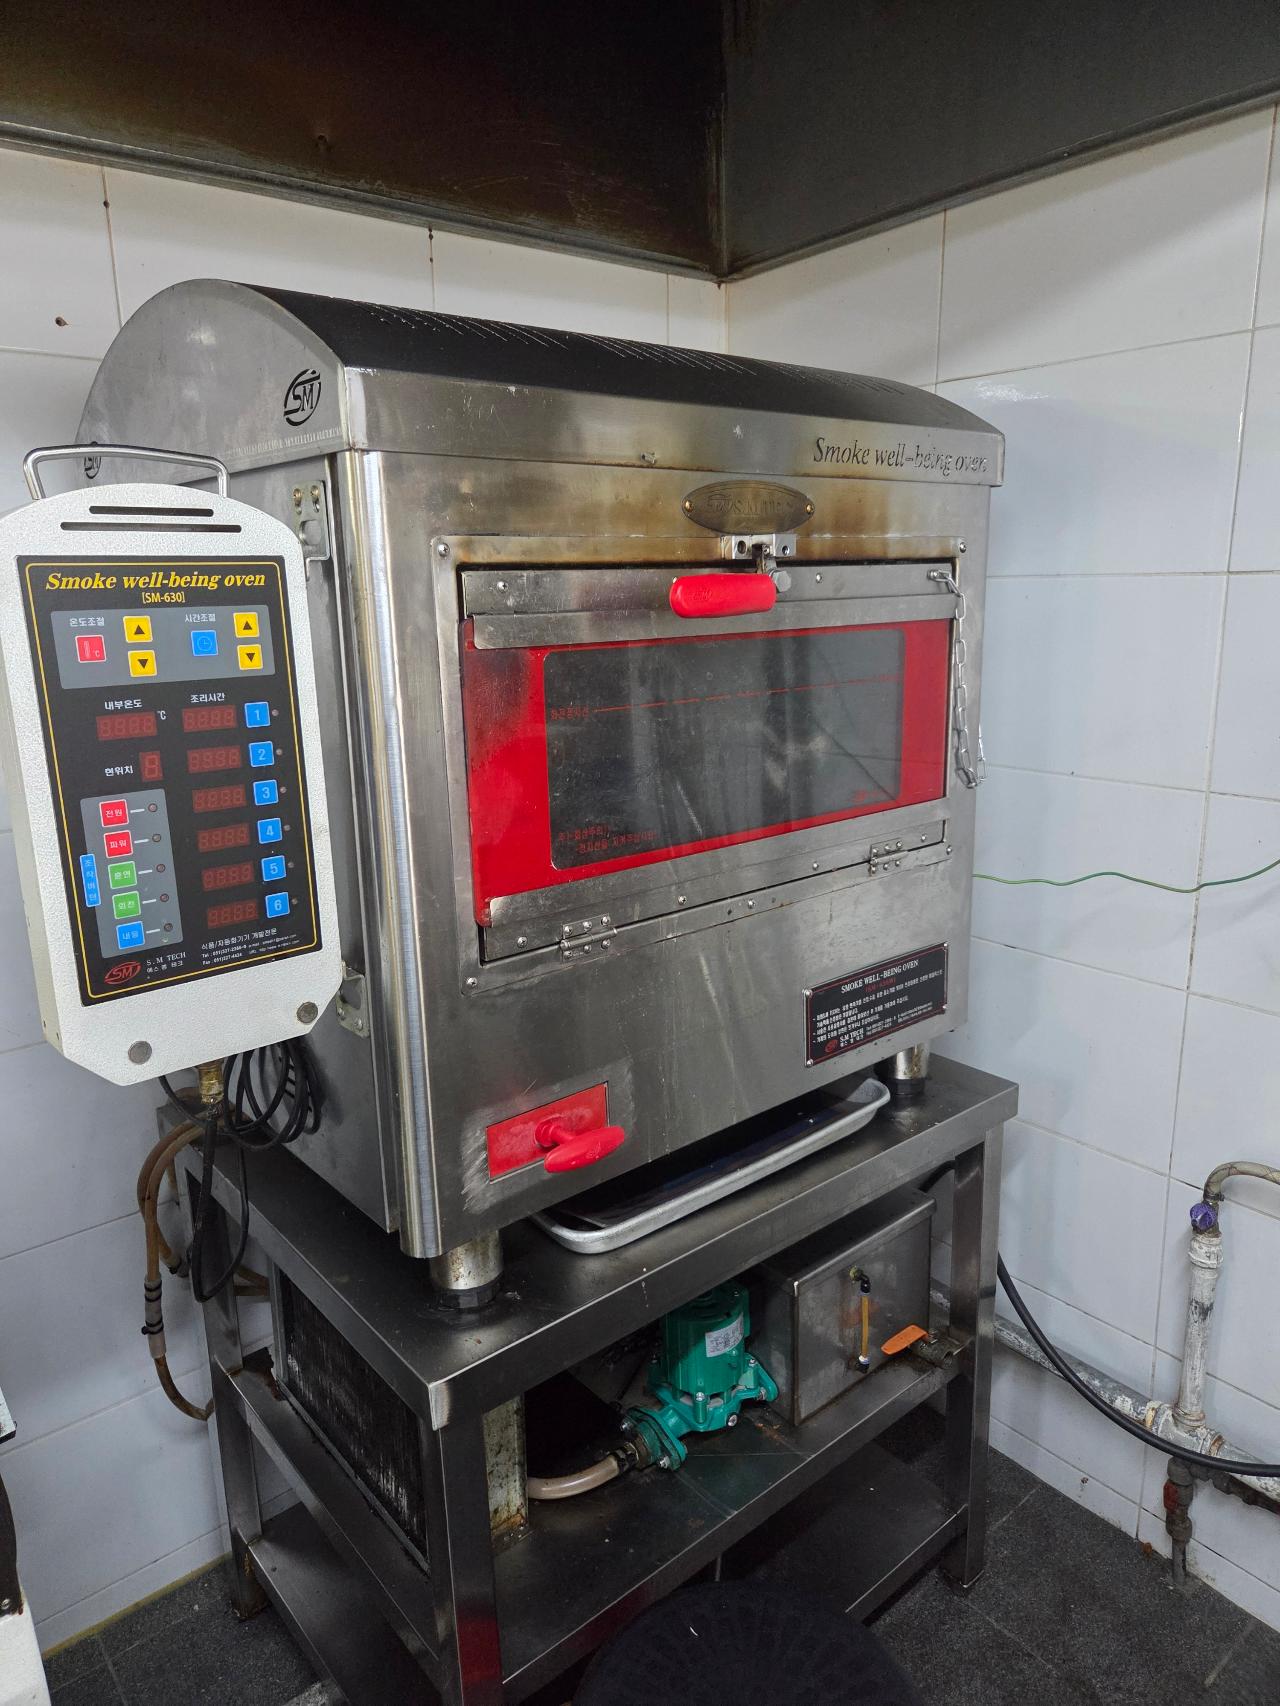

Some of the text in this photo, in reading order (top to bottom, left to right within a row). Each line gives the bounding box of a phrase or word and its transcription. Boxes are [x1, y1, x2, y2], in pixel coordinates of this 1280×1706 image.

[813, 436, 988, 477] Smoke well-being oven
[46, 571, 266, 590] Smoke well-being oven
[142, 591, 186, 604] [SM-630]
[69, 617, 105, 627] 온도조절
[185, 613, 216, 623] 시간조절
[190, 692, 225, 703] 조리시간
[104, 698, 142, 711] 내부온도
[254, 709, 261, 721] 1
[258, 748, 267, 761] 2
[105, 765, 133, 777] 현위치
[262, 786, 270, 800] 3
[266, 824, 274, 838] 4
[269, 862, 278, 875] 5
[274, 899, 282, 912] 6
[167, 952, 187, 962] TECH
[841, 979, 863, 993] SMOKE
[864, 965, 902, 984] WELL-BEING
[902, 959, 919, 971] OVEN
